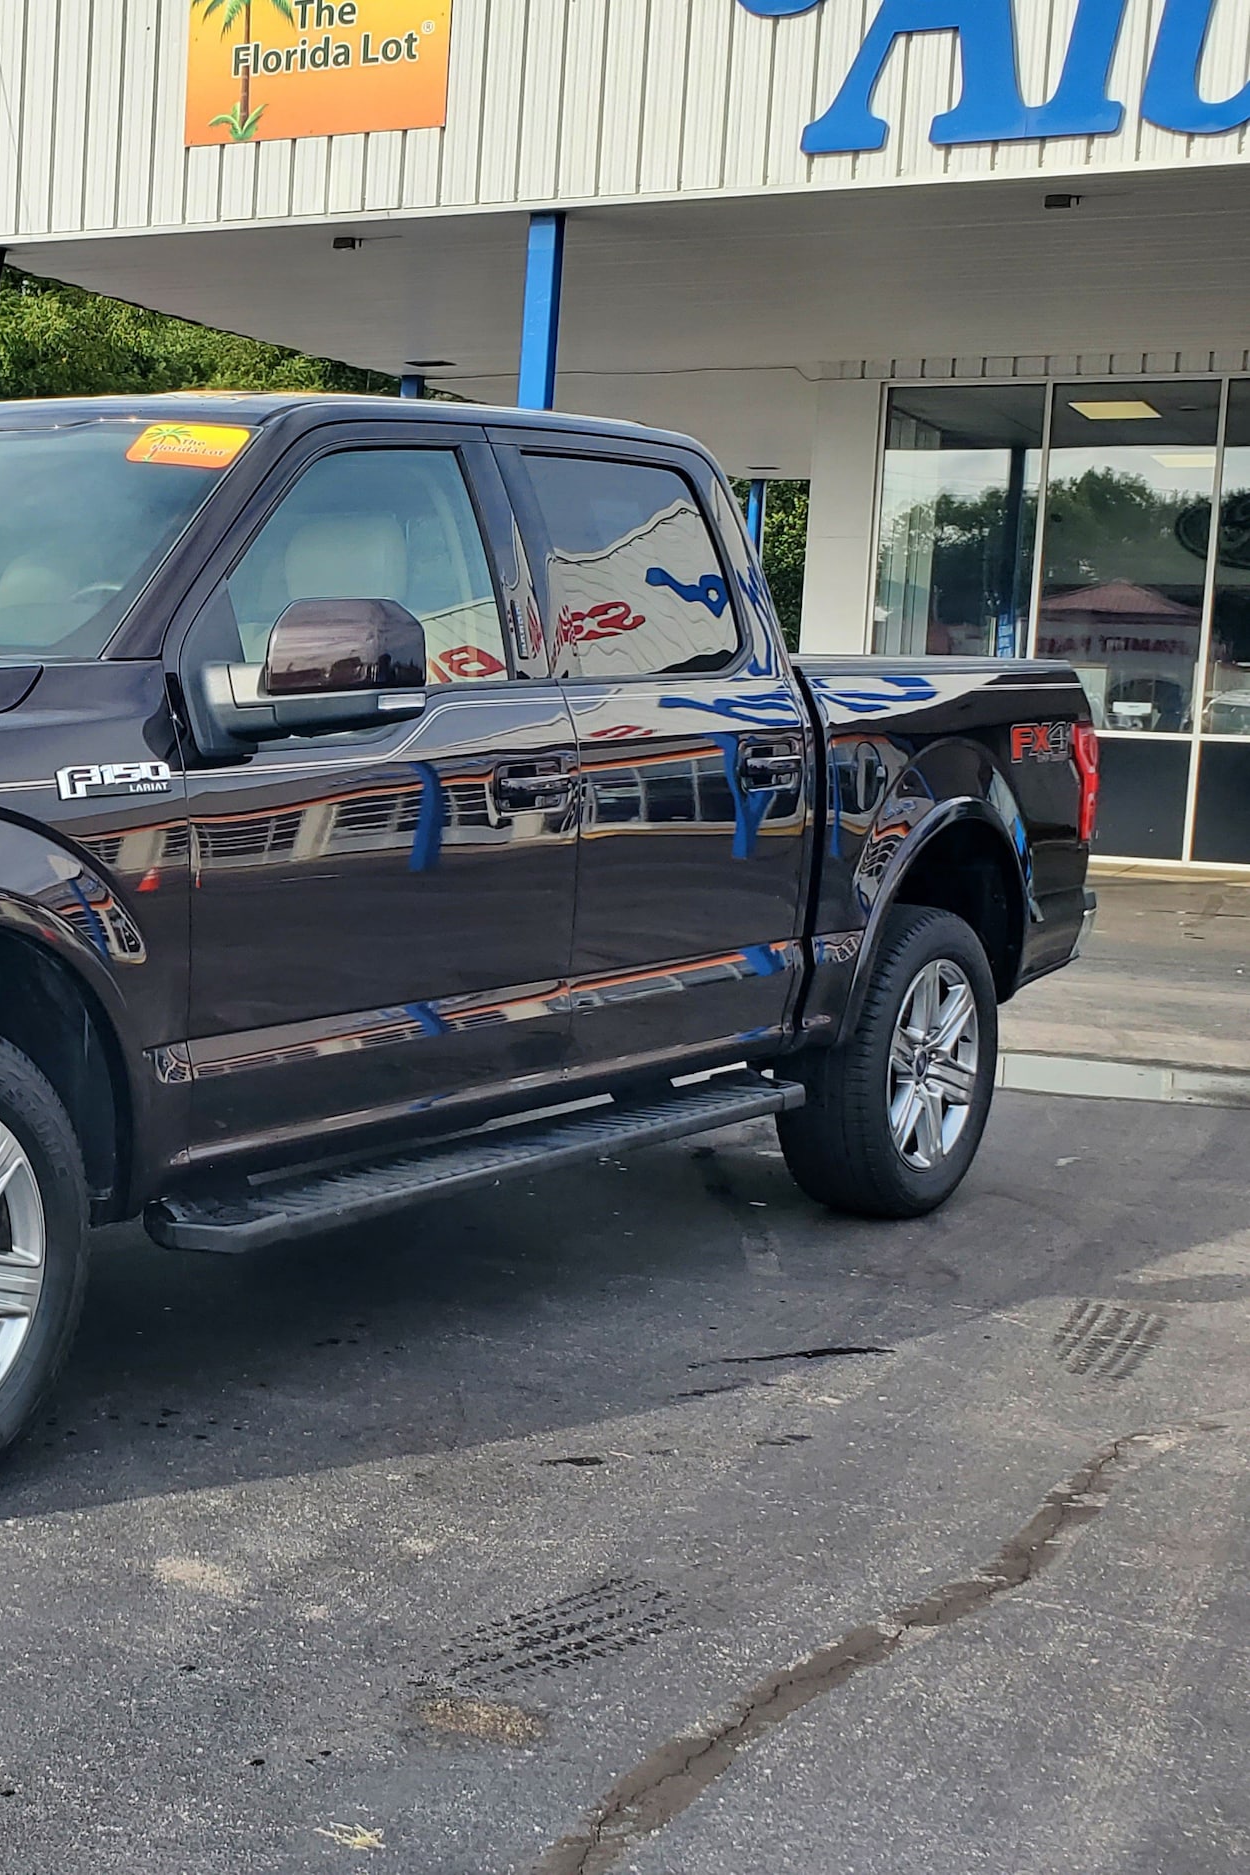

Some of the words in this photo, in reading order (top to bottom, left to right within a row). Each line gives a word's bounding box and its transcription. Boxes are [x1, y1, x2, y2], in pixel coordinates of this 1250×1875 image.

[294, 0, 356, 29] The
[233, 36, 350, 76] Florida
[1010, 721, 1068, 764] FX4
[129, 782, 169, 793] LARIAT
